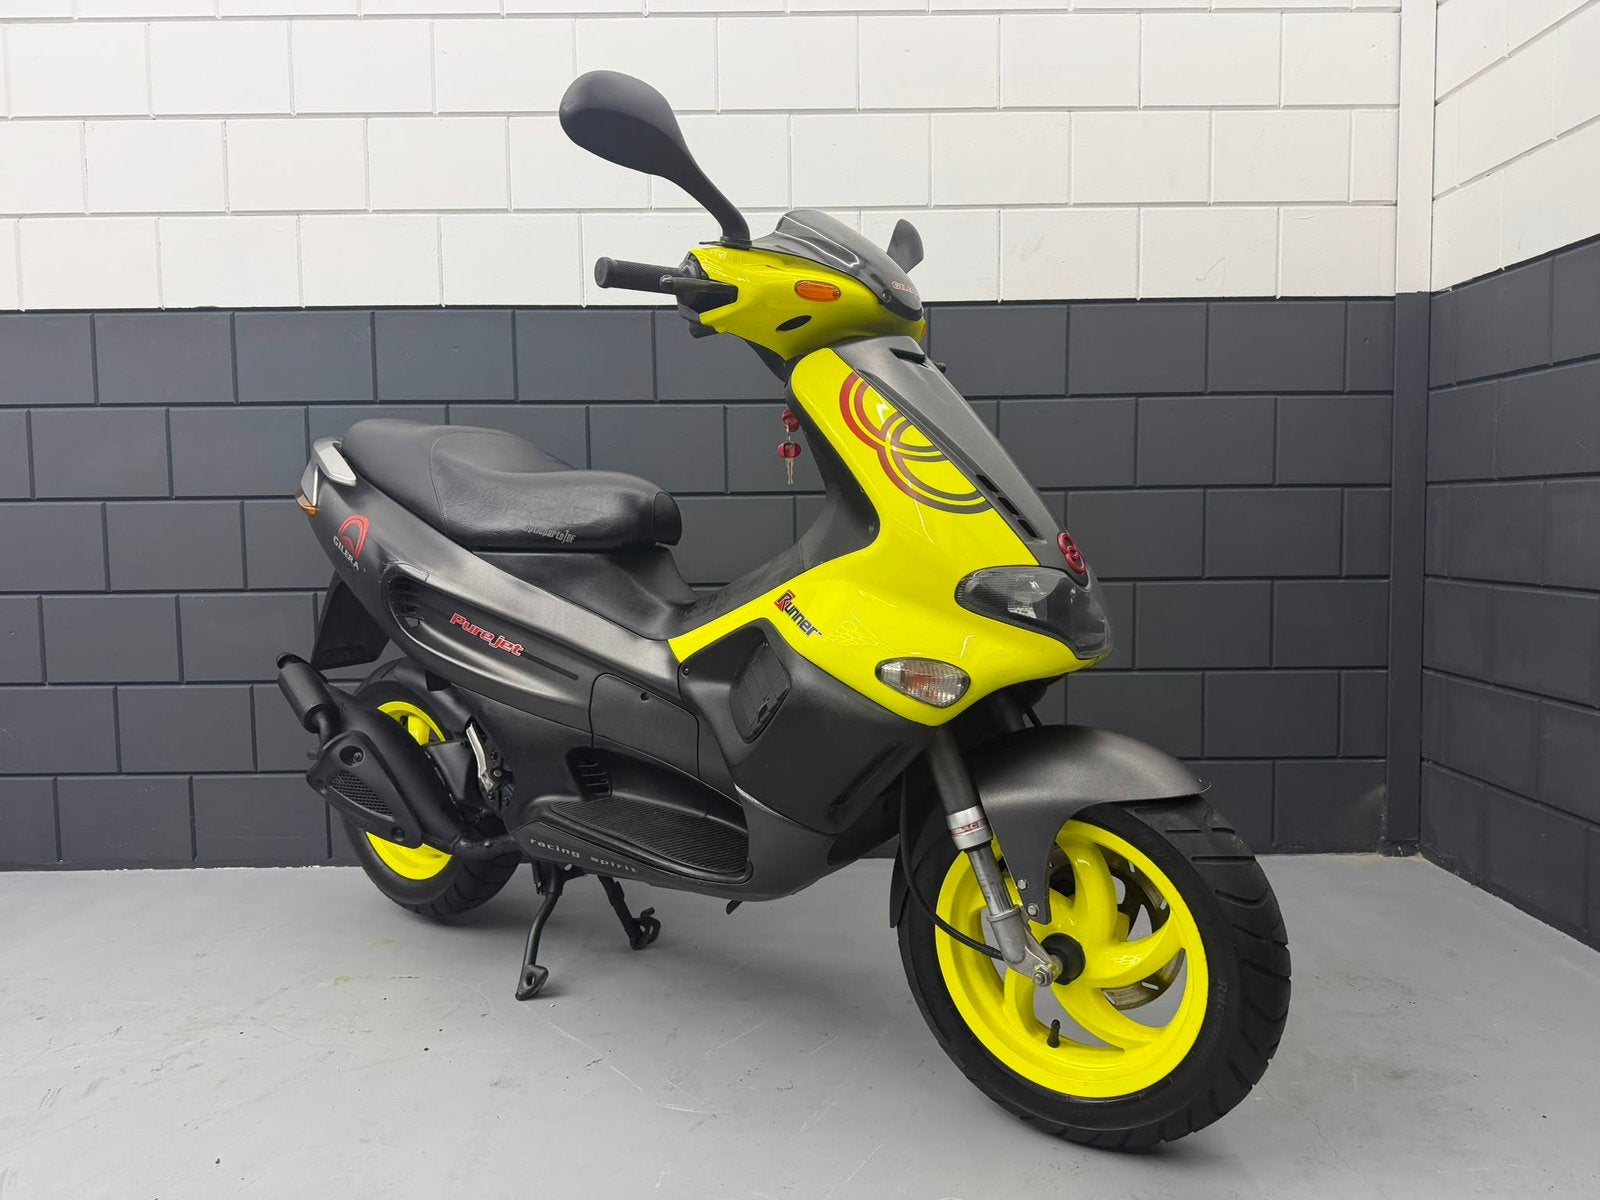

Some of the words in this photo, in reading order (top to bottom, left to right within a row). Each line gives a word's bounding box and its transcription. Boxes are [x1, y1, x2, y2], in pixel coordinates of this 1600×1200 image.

[333, 535, 359, 571] GILERA
[774, 589, 823, 637] Runner
[530, 838, 580, 859] racing
[590, 856, 638, 873] spirit
